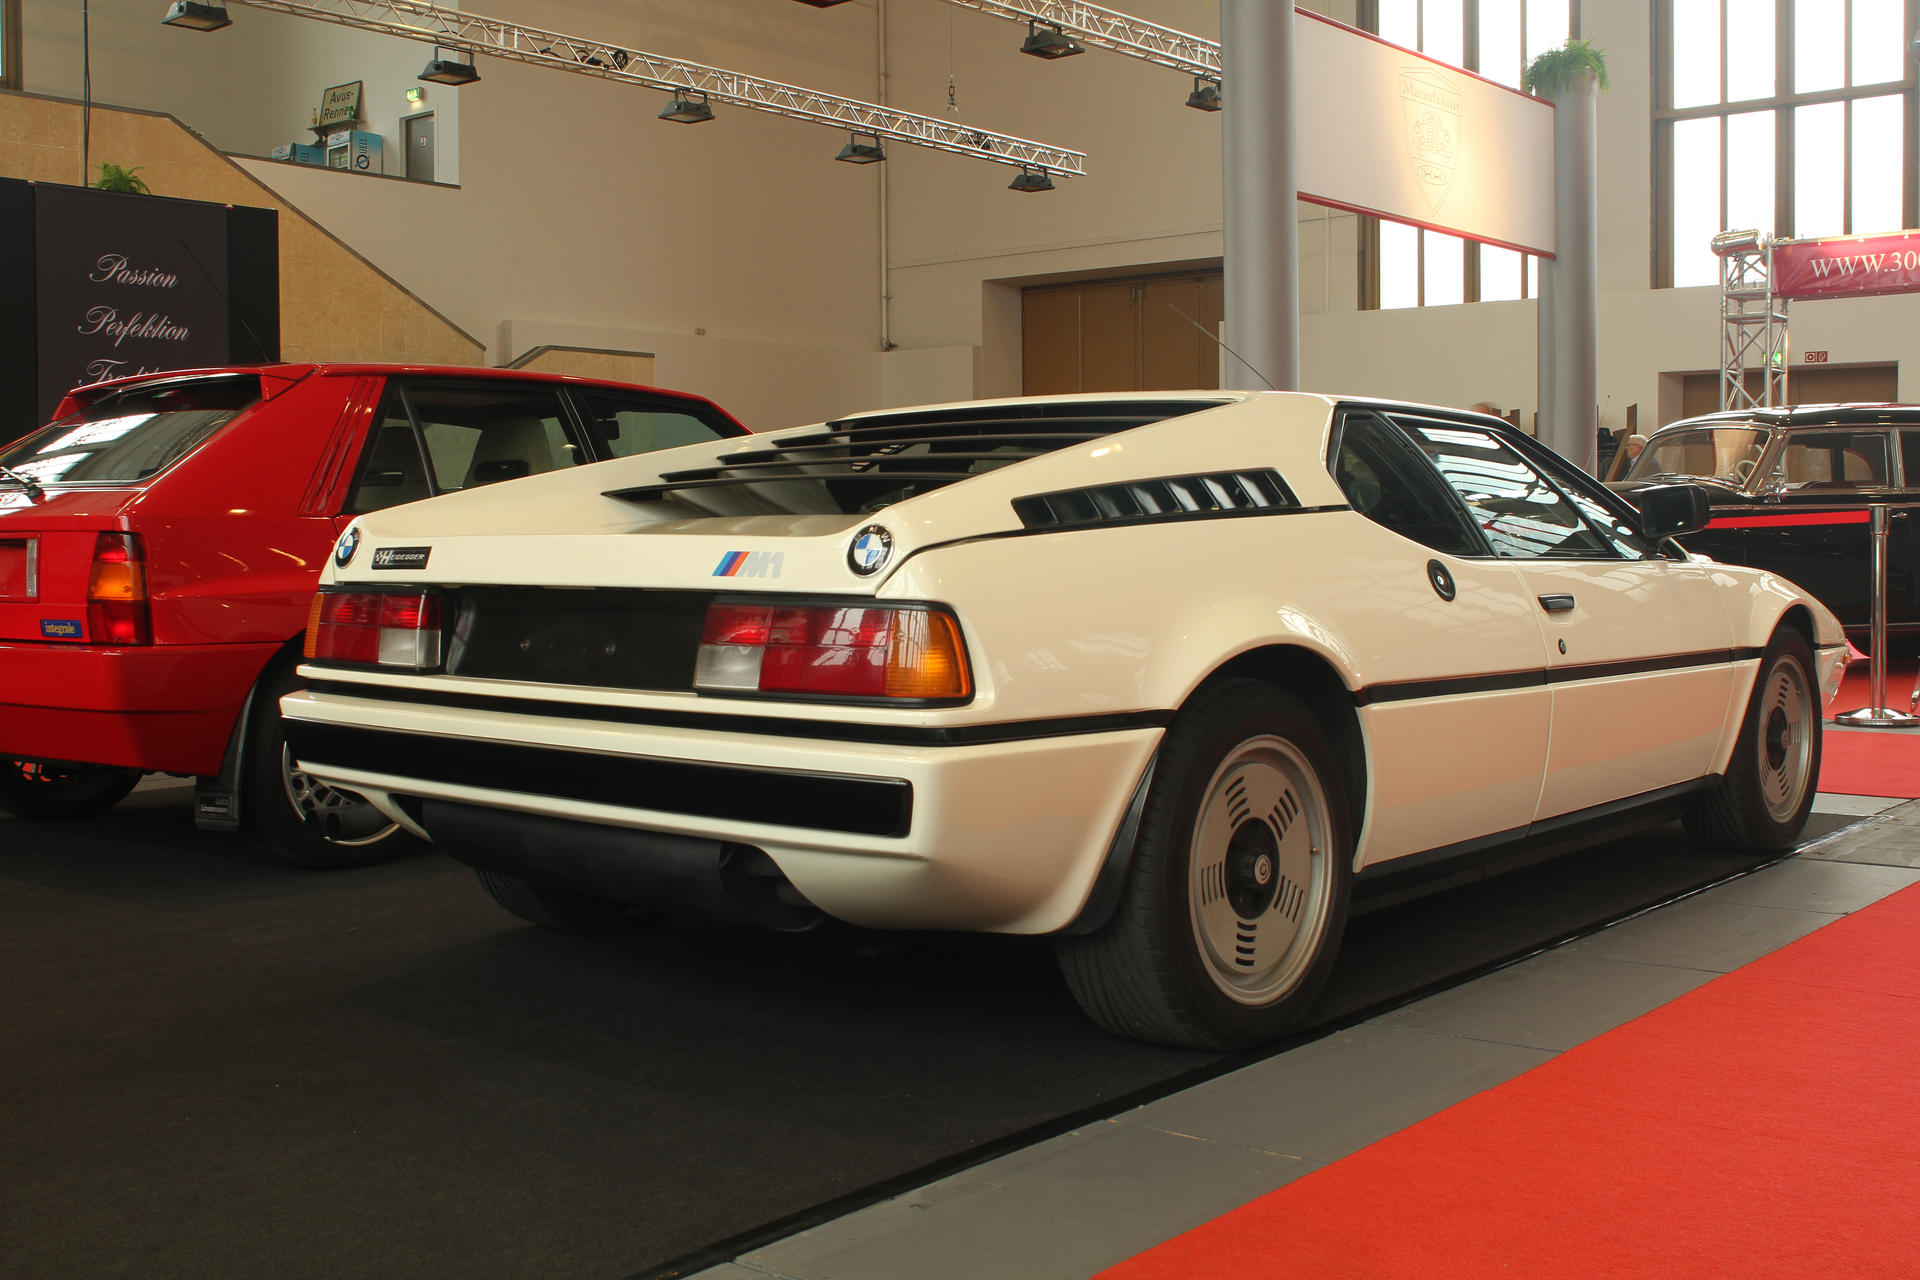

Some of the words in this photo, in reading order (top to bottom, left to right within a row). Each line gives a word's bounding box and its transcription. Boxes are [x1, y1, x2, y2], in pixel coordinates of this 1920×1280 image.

[330, 91, 354, 104] Avus-
[323, 107, 353, 120] Renne
[89, 253, 178, 288] Passion
[1810, 250, 1920, 278] WWW.30
[77, 305, 190, 347] Perfektion
[736, 551, 785, 578] M1
[44, 621, 76, 636] integrale
